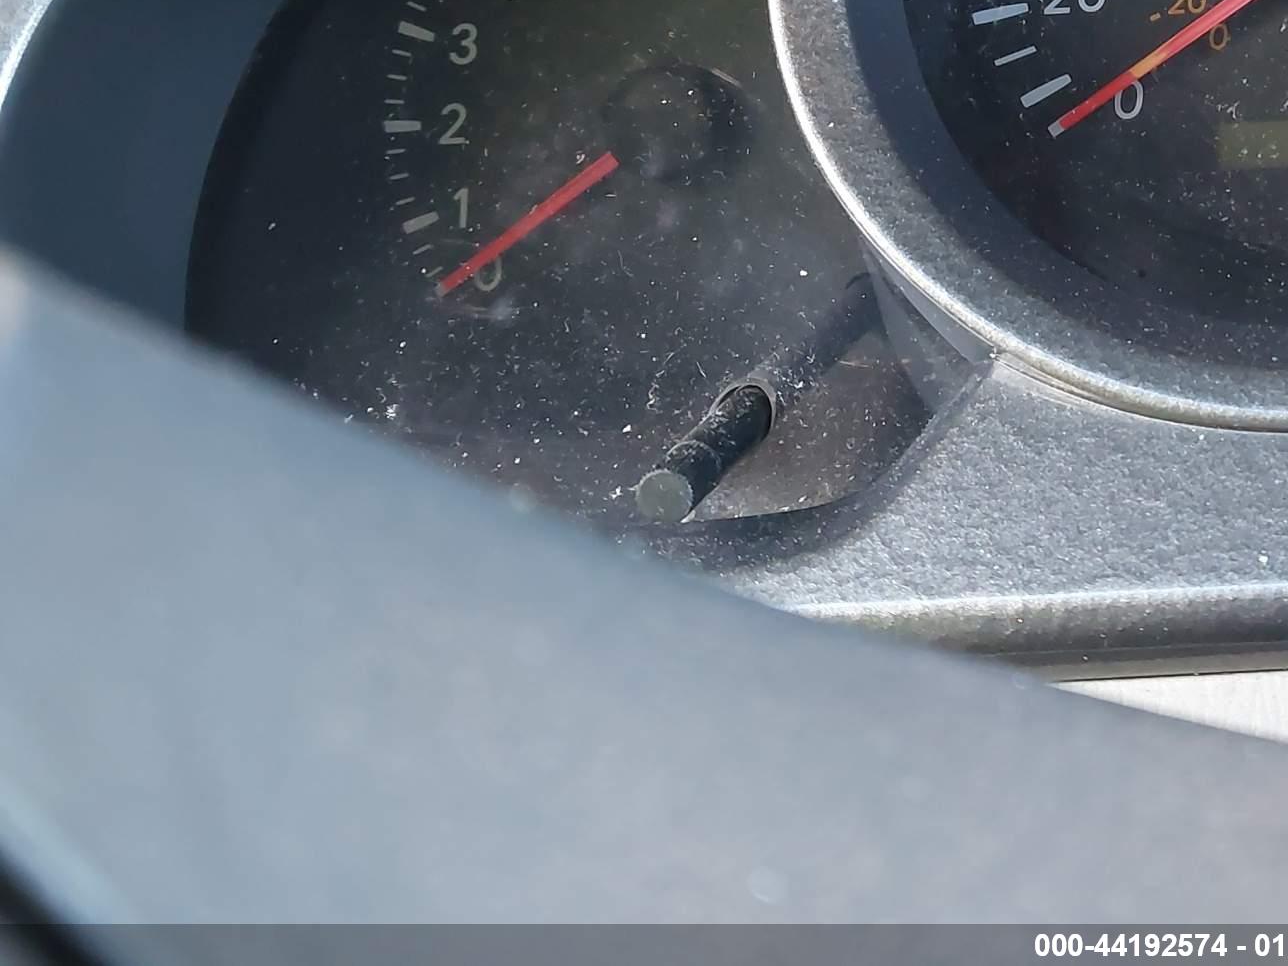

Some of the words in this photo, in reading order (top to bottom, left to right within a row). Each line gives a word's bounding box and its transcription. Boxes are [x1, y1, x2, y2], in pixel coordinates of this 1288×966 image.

[449, 23, 477, 65] 3
[1209, 24, 1231, 51] 0
[1113, 79, 1144, 120] 0
[439, 103, 469, 145] 2
[452, 188, 468, 229] 1
[474, 251, 502, 291] 0
